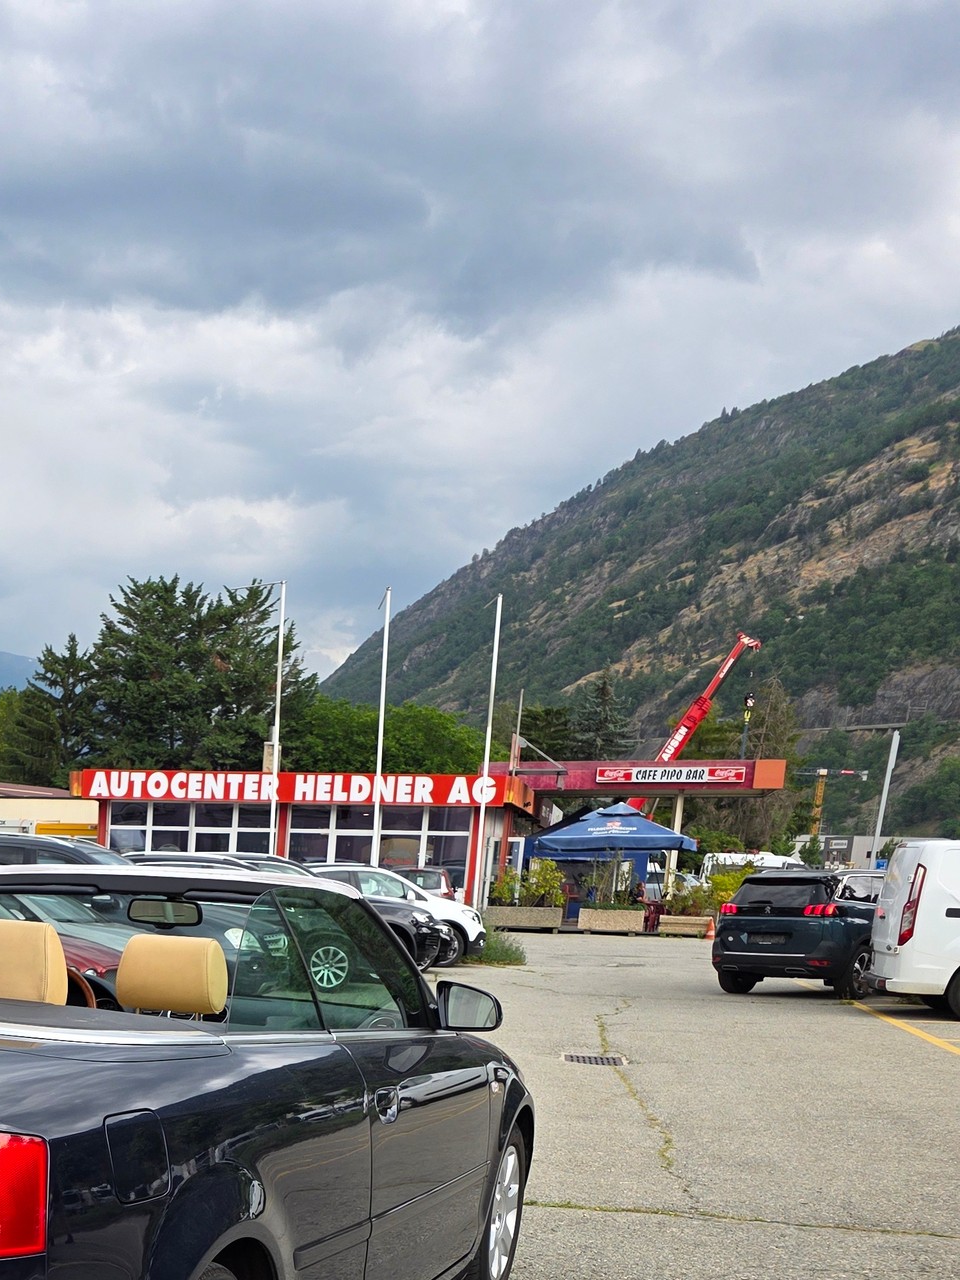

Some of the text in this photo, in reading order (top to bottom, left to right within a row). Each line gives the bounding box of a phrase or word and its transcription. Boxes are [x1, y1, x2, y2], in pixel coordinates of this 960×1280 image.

[635, 769, 705, 780] CAFE PIPO BAR
[89, 771, 496, 804] AUTOCENTER HELDNER AG
